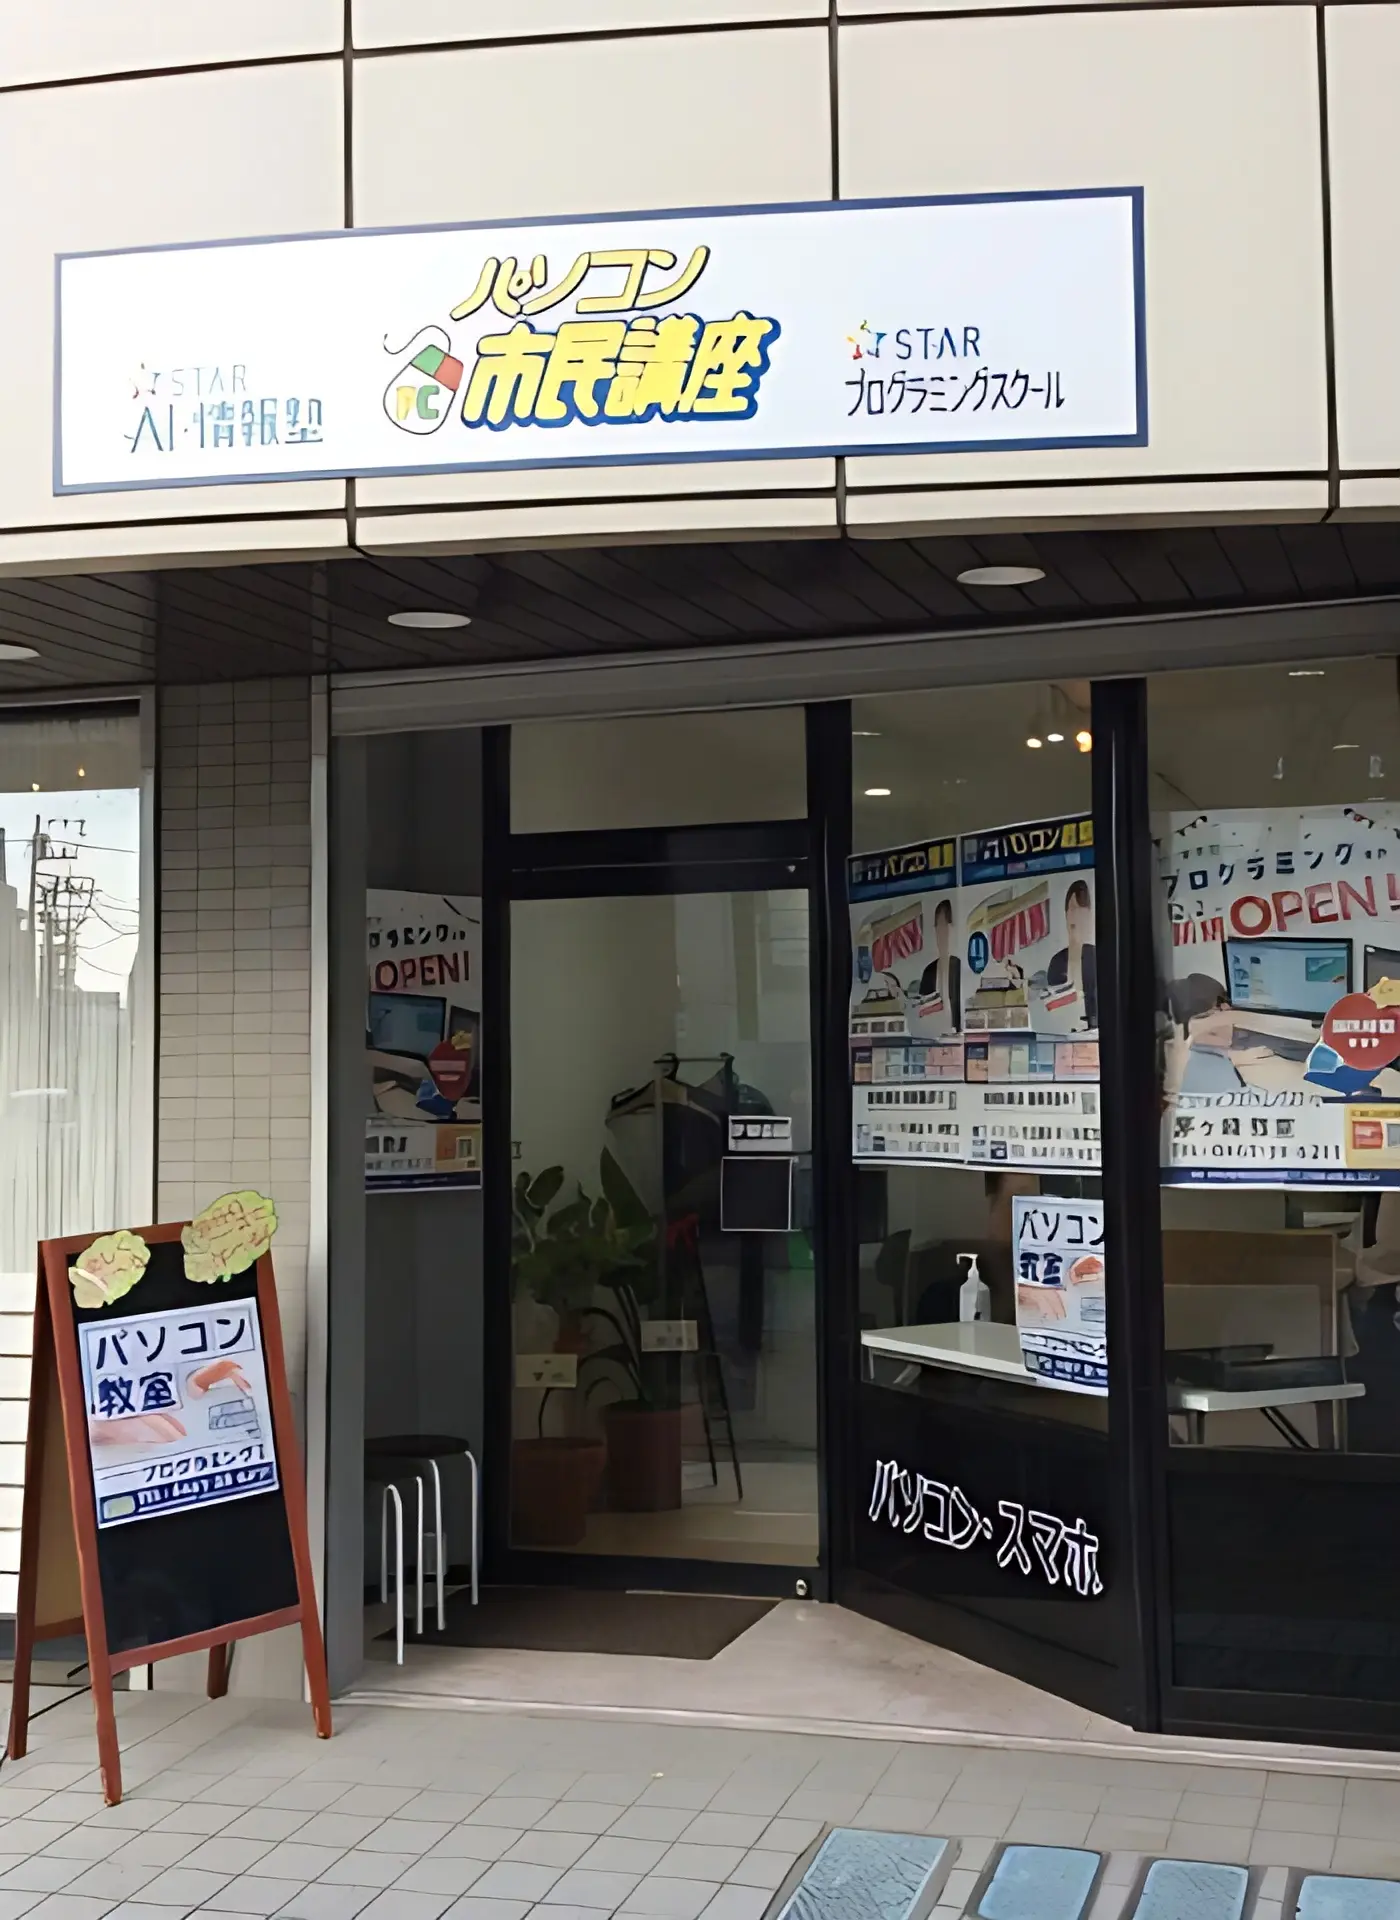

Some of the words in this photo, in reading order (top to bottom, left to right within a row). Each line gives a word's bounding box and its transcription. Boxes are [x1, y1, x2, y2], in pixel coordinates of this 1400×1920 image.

[450, 245, 711, 321] パソコン
[895, 326, 981, 360] STAR
[171, 364, 246, 396] STAR
[461, 310, 779, 429] 市民講座
[845, 367, 1066, 416] プログラミングスクール
[1019, 1209, 1104, 1246] パソコン
[96, 1318, 246, 1370] パソコン
